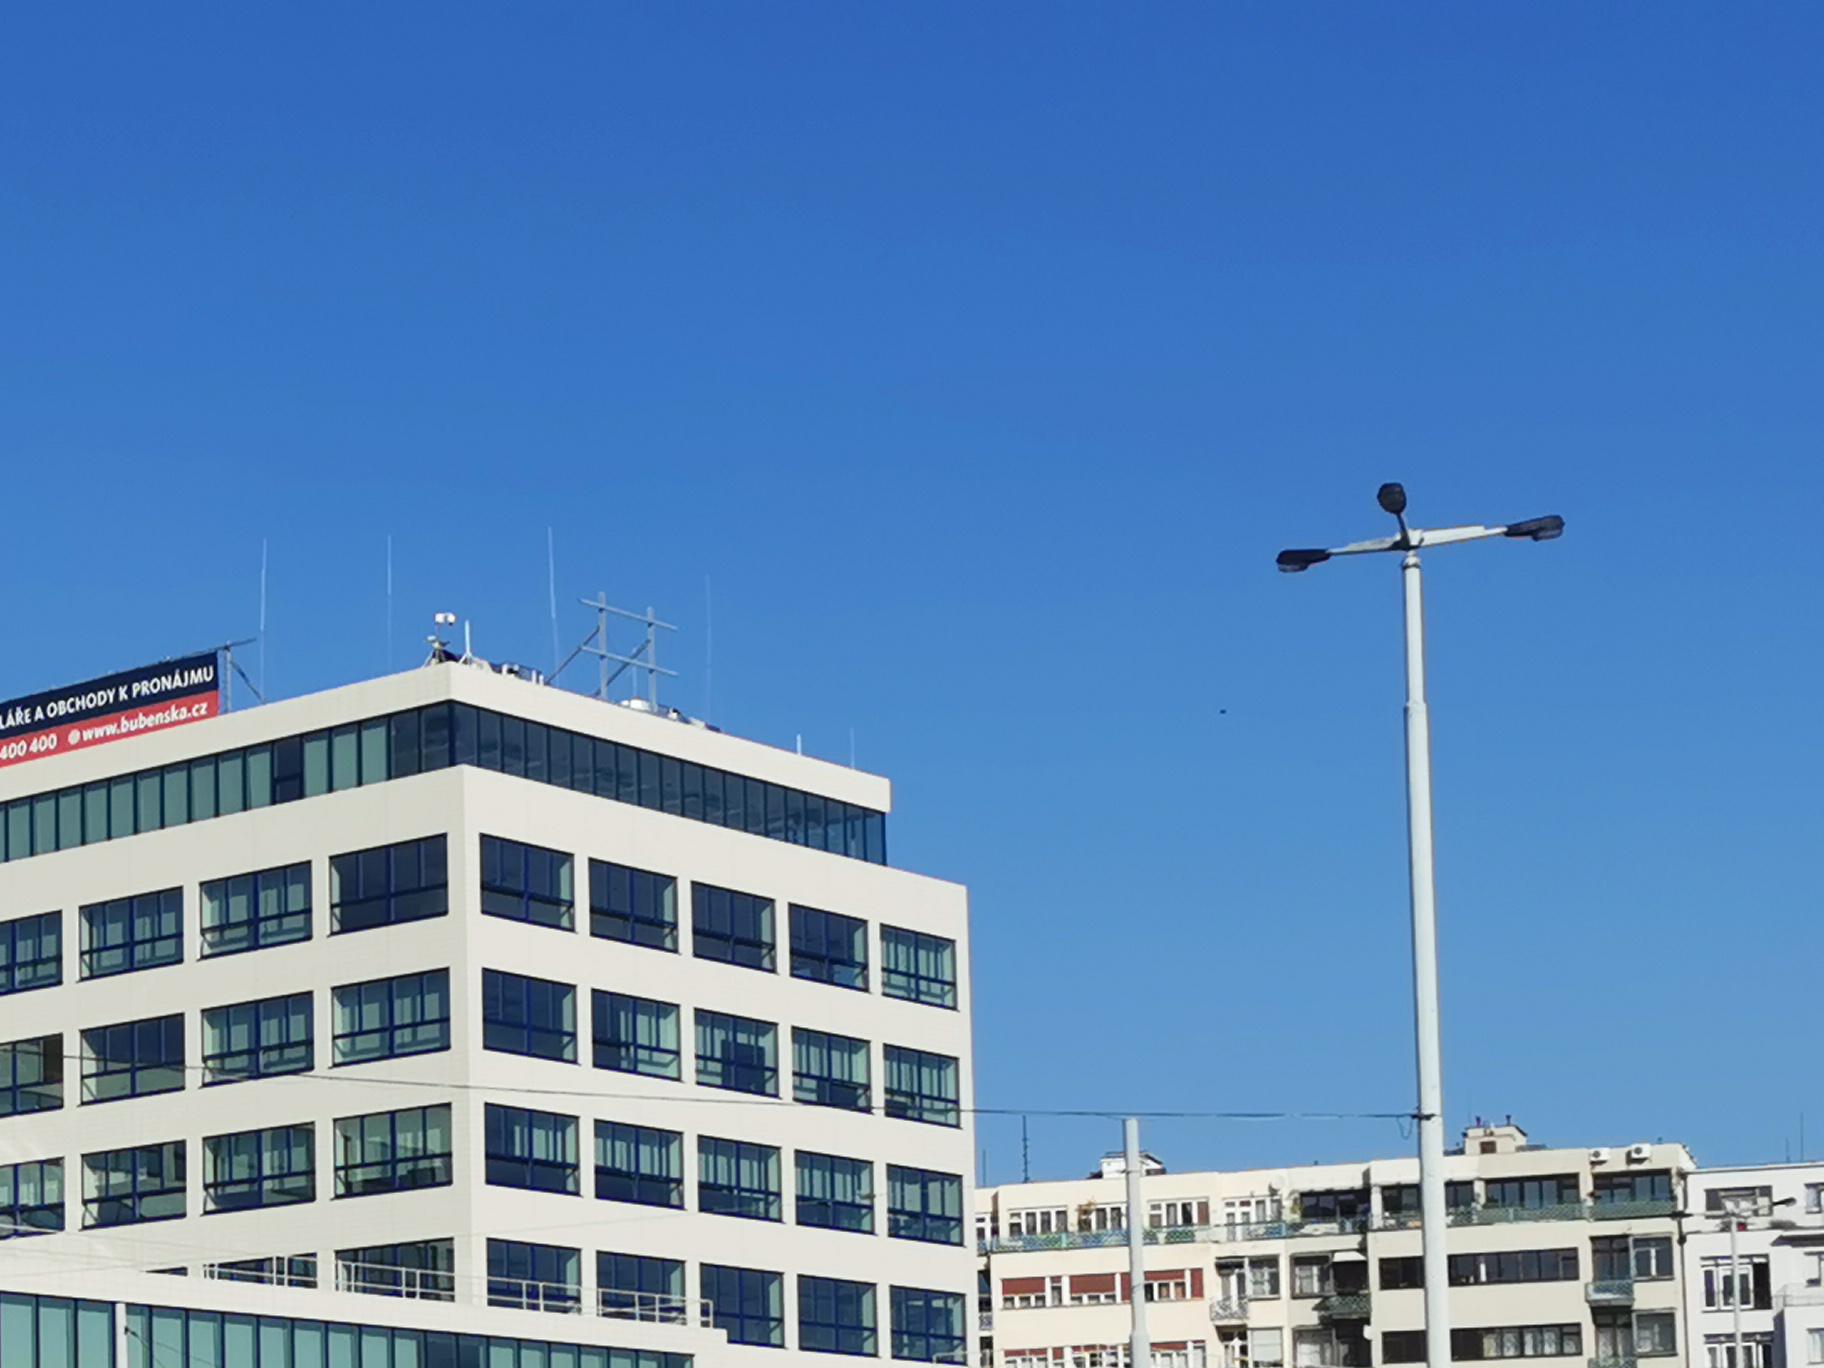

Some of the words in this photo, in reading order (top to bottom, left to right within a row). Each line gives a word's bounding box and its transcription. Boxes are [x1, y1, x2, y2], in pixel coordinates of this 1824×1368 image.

[34, 705, 45, 720] A
[46, 687, 116, 718] OBCHODY
[119, 685, 128, 701] K
[132, 665, 214, 698] PRONÁJMU
[82, 702, 208, 741] www.bubenska.cz
[0, 740, 27, 759] 400
[29, 733, 57, 753] 400
